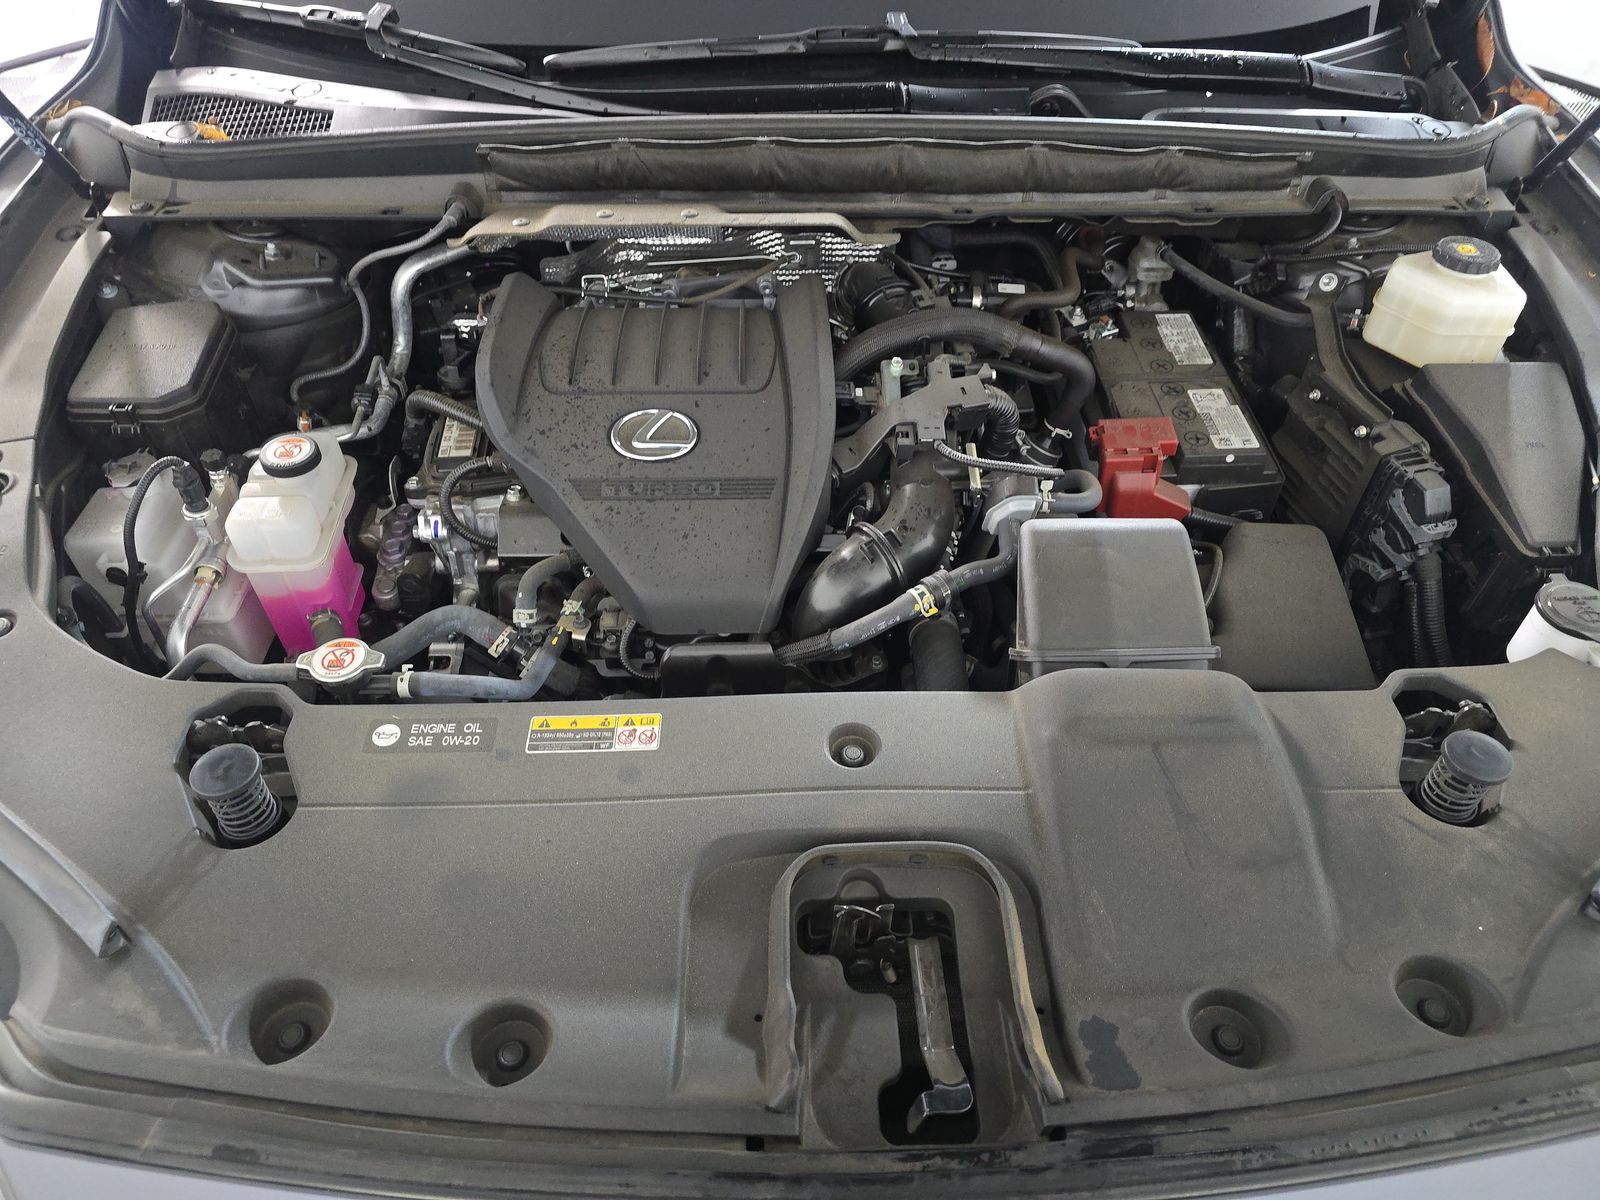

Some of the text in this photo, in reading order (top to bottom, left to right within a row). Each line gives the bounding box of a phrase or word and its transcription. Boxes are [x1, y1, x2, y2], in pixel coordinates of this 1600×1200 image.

[410, 722, 483, 734] ENGINE OIL
[407, 735, 480, 746] SAE 0W-20
